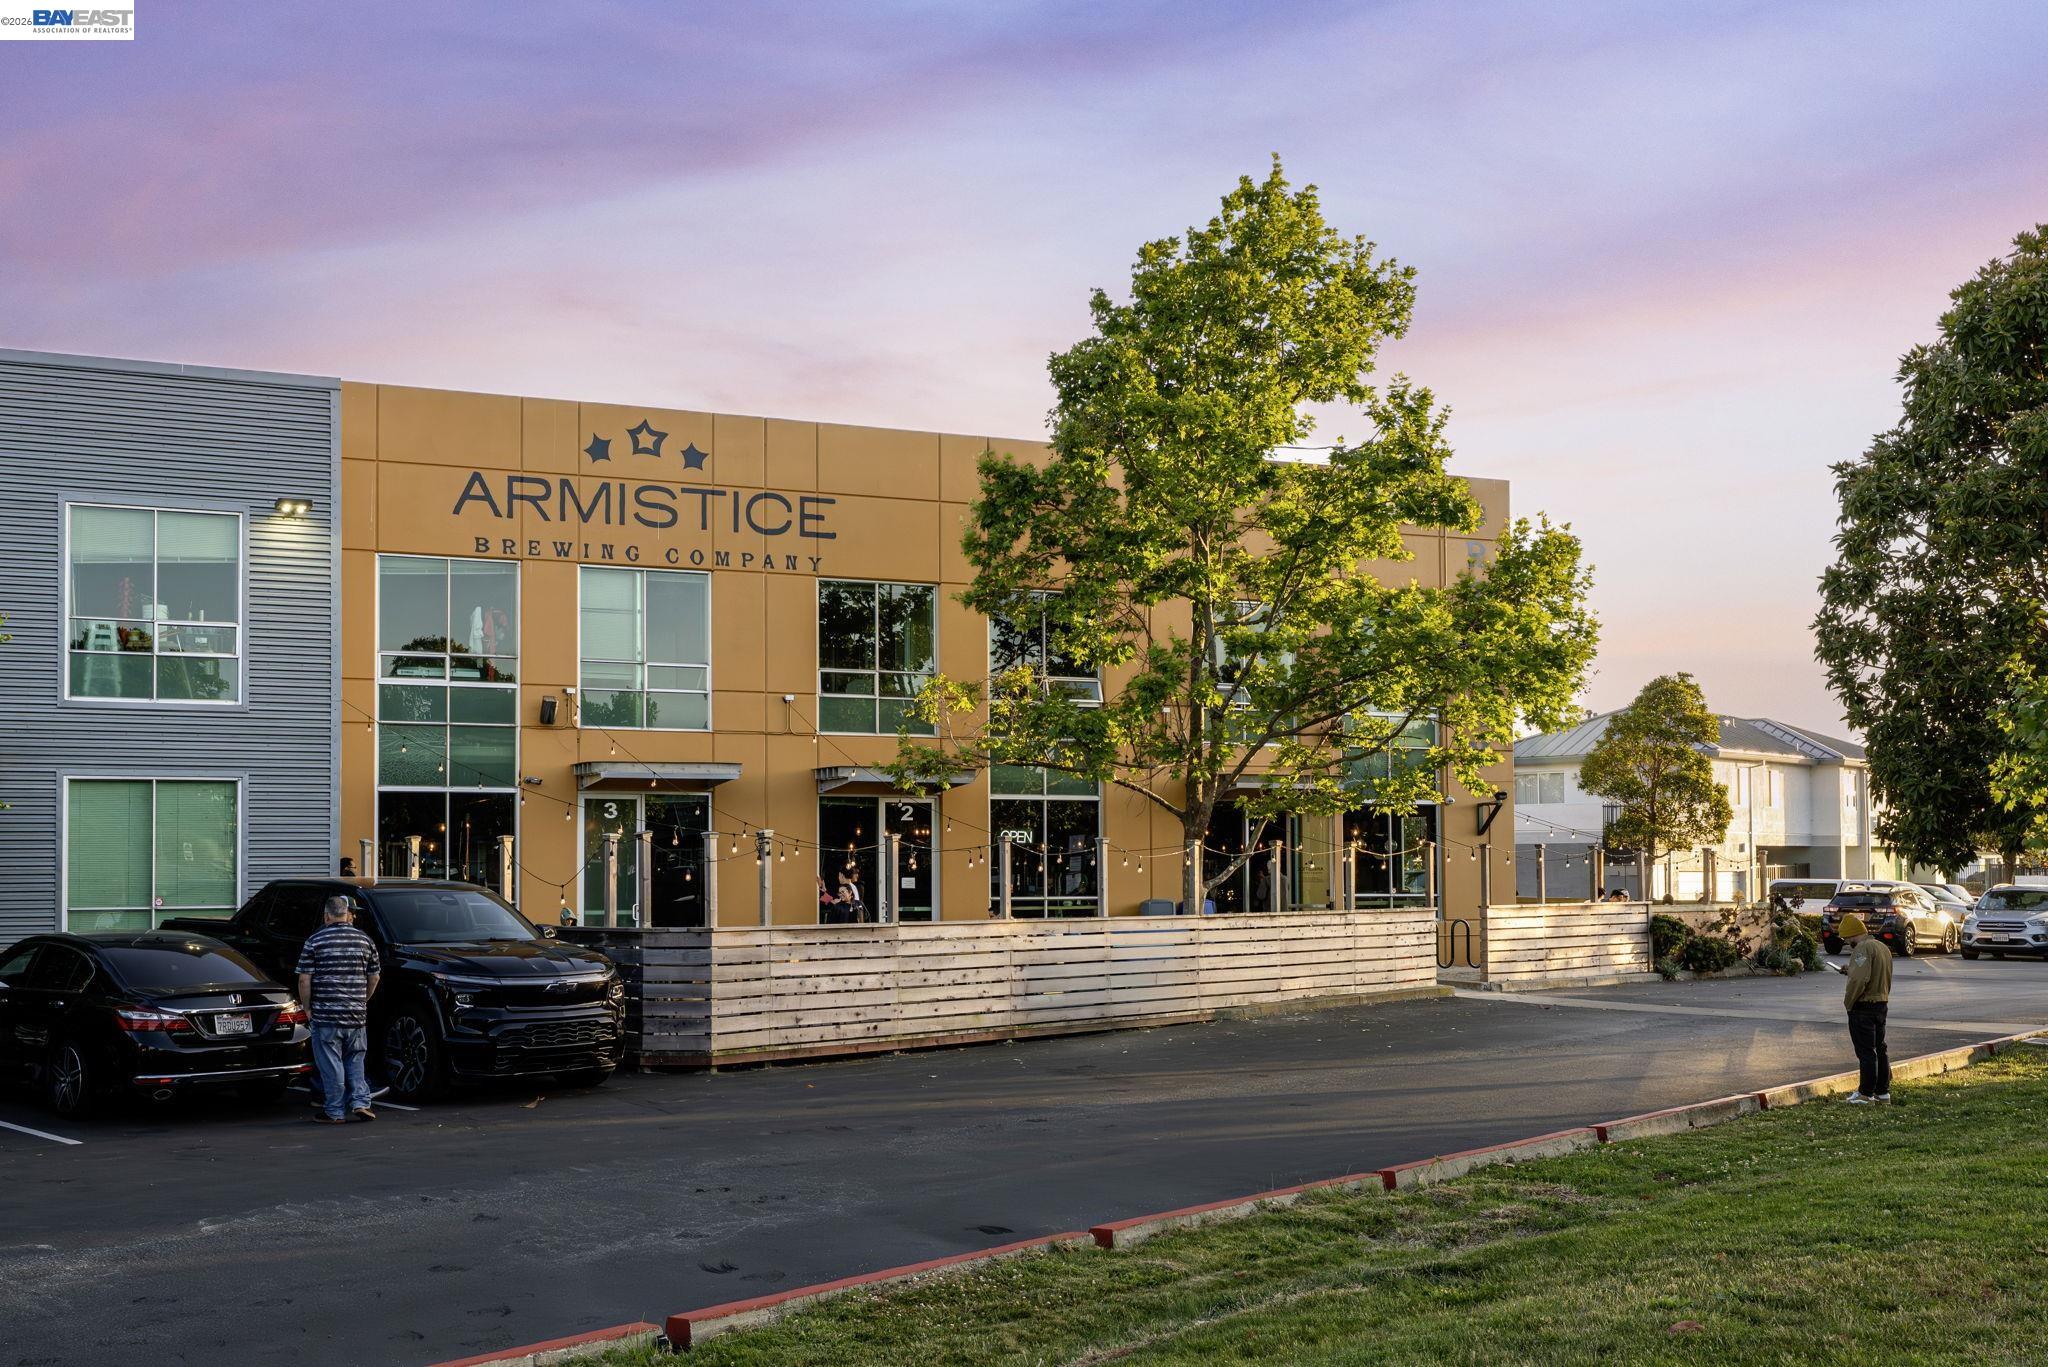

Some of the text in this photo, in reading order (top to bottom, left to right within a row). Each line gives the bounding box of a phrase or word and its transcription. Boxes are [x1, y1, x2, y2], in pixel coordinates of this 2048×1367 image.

[452, 471, 837, 540] ARMISTICE
[474, 536, 823, 572] BREWING COMPANY
[603, 802, 618, 819] 3
[900, 805, 914, 821] 2
